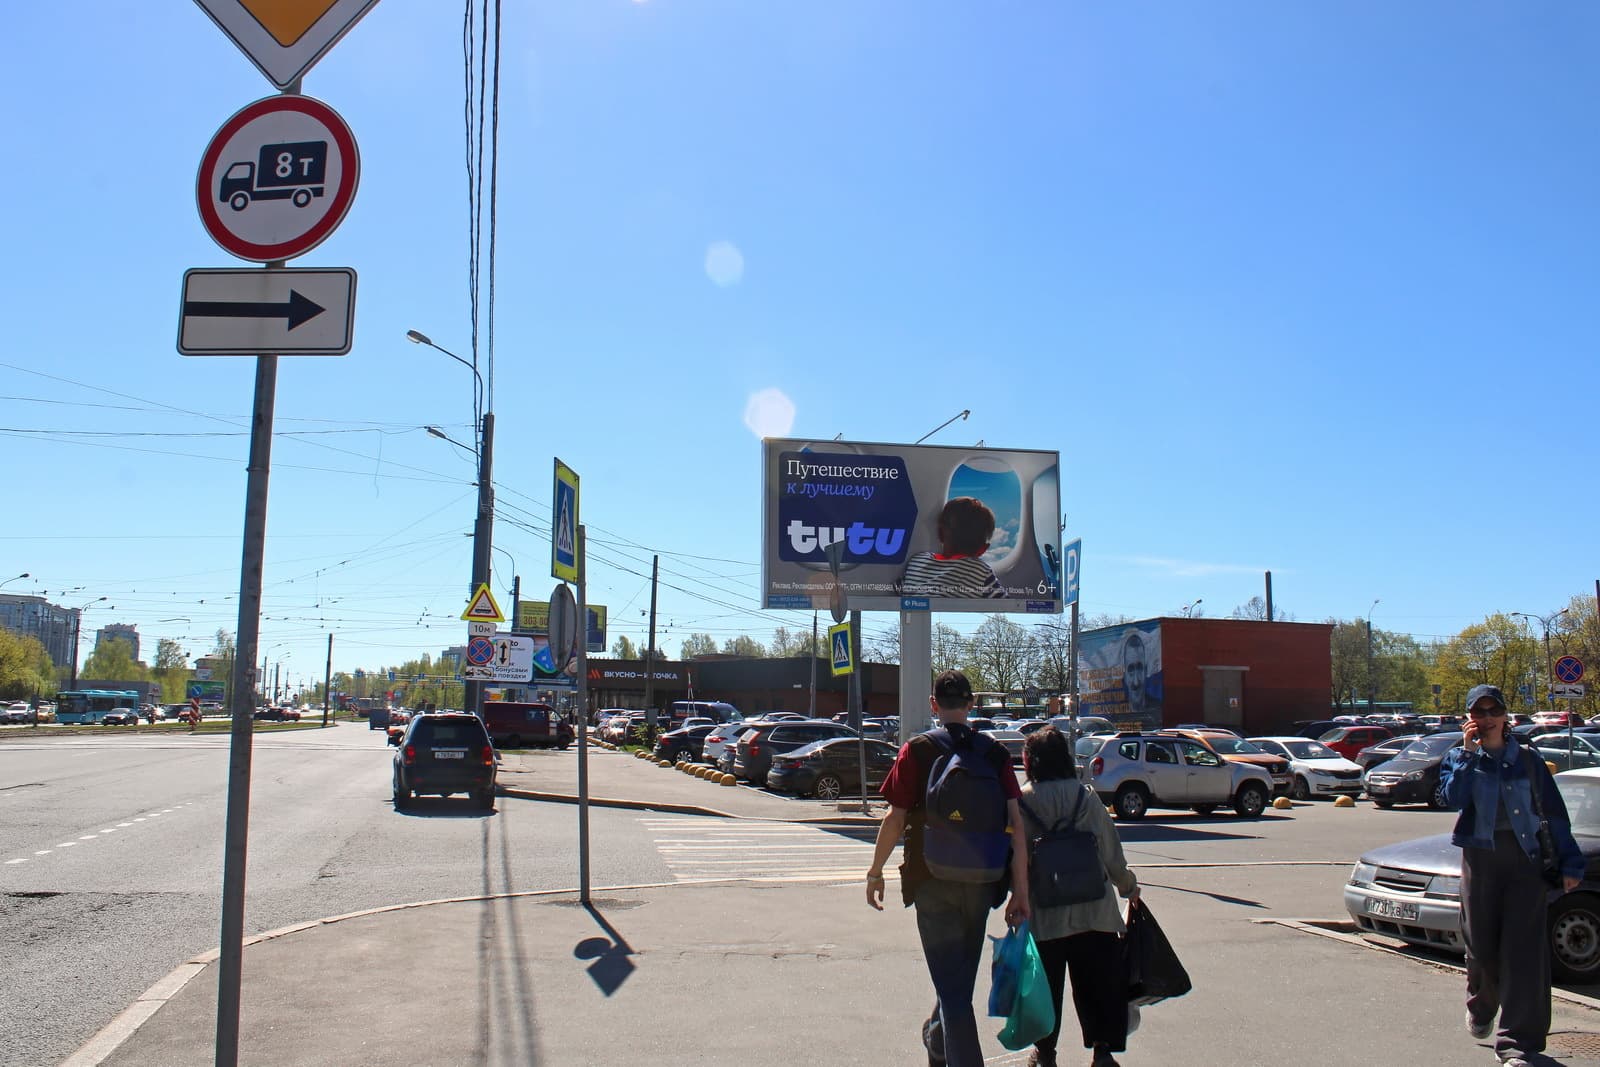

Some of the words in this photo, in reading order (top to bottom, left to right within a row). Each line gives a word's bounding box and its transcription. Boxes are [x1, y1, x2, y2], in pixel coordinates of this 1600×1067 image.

[275, 152, 292, 178] 8
[787, 459, 899, 480] Путешествие
[786, 482, 797, 494] к
[800, 482, 875, 500] лучшему
[787, 519, 906, 556] tutu
[1036, 580, 1057, 595] 6+
